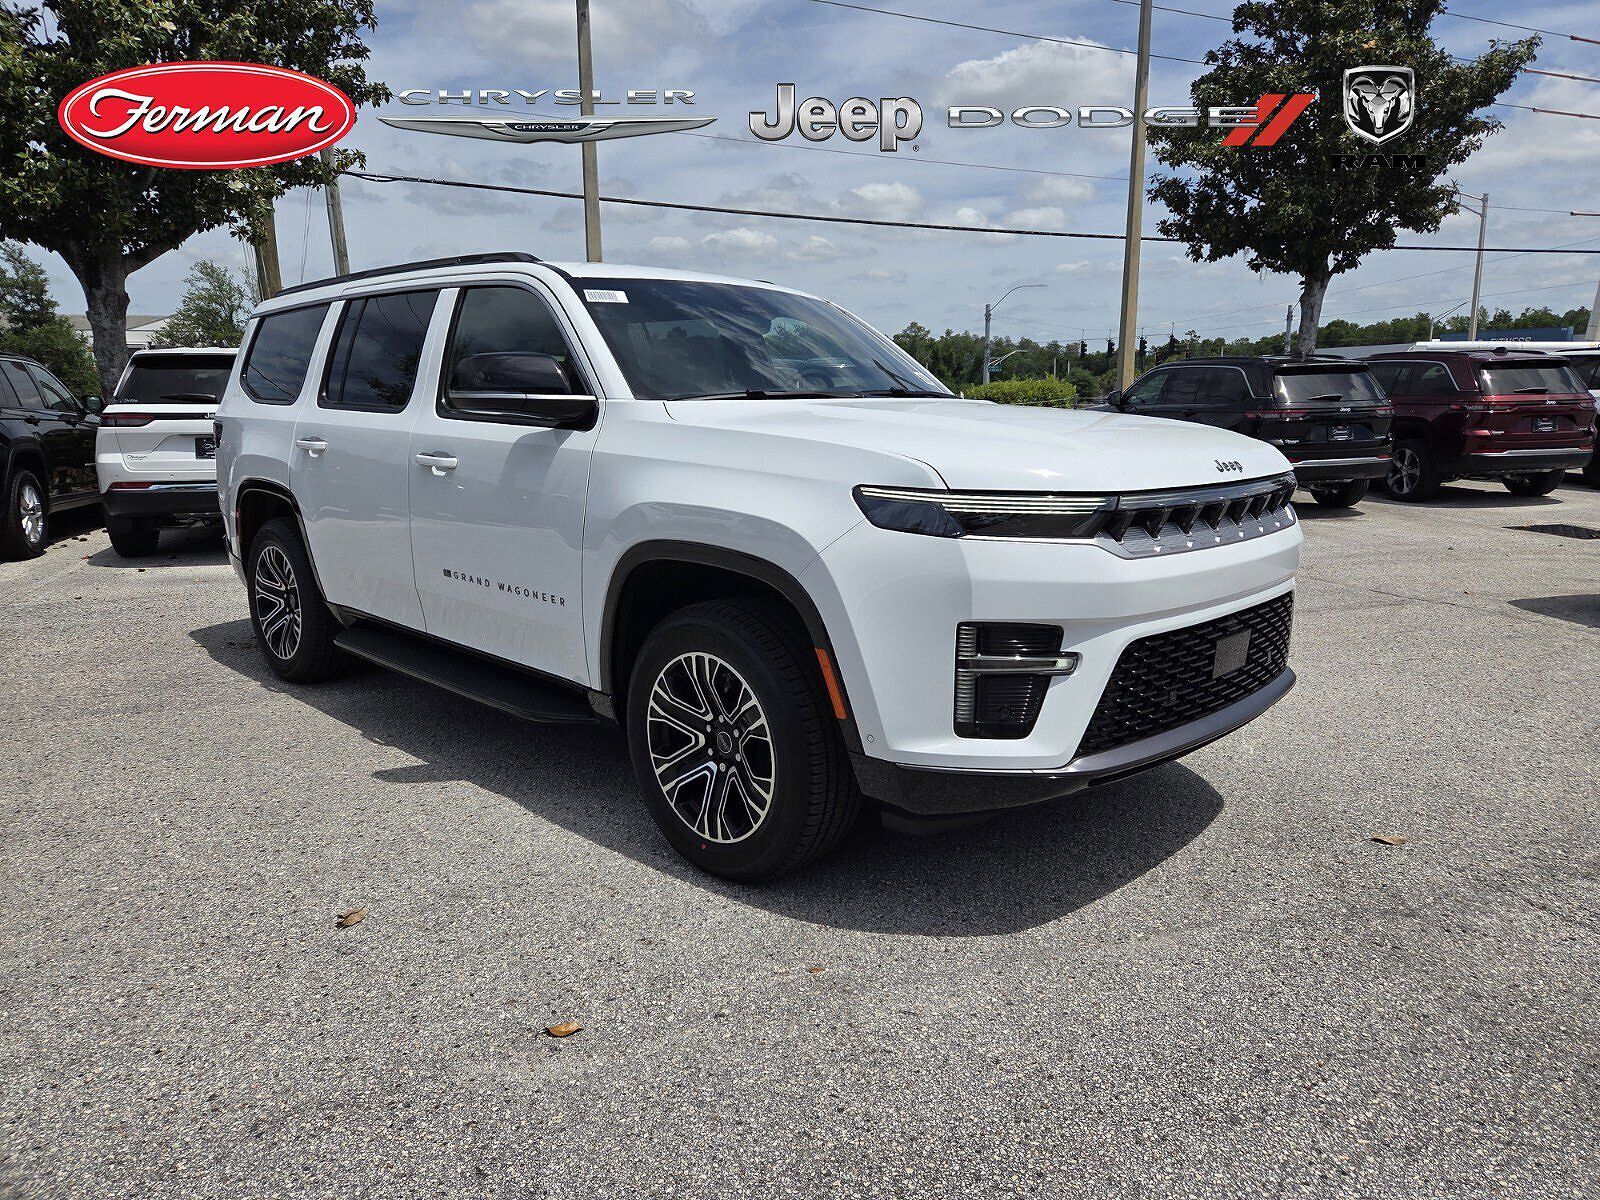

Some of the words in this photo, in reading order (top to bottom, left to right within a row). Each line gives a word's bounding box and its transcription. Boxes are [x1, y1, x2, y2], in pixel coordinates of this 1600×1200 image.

[204, 411, 216, 420] Je
[1214, 459, 1243, 473] Jeep
[453, 571, 490, 587] GRAND
[497, 582, 565, 606] WAGONEER
